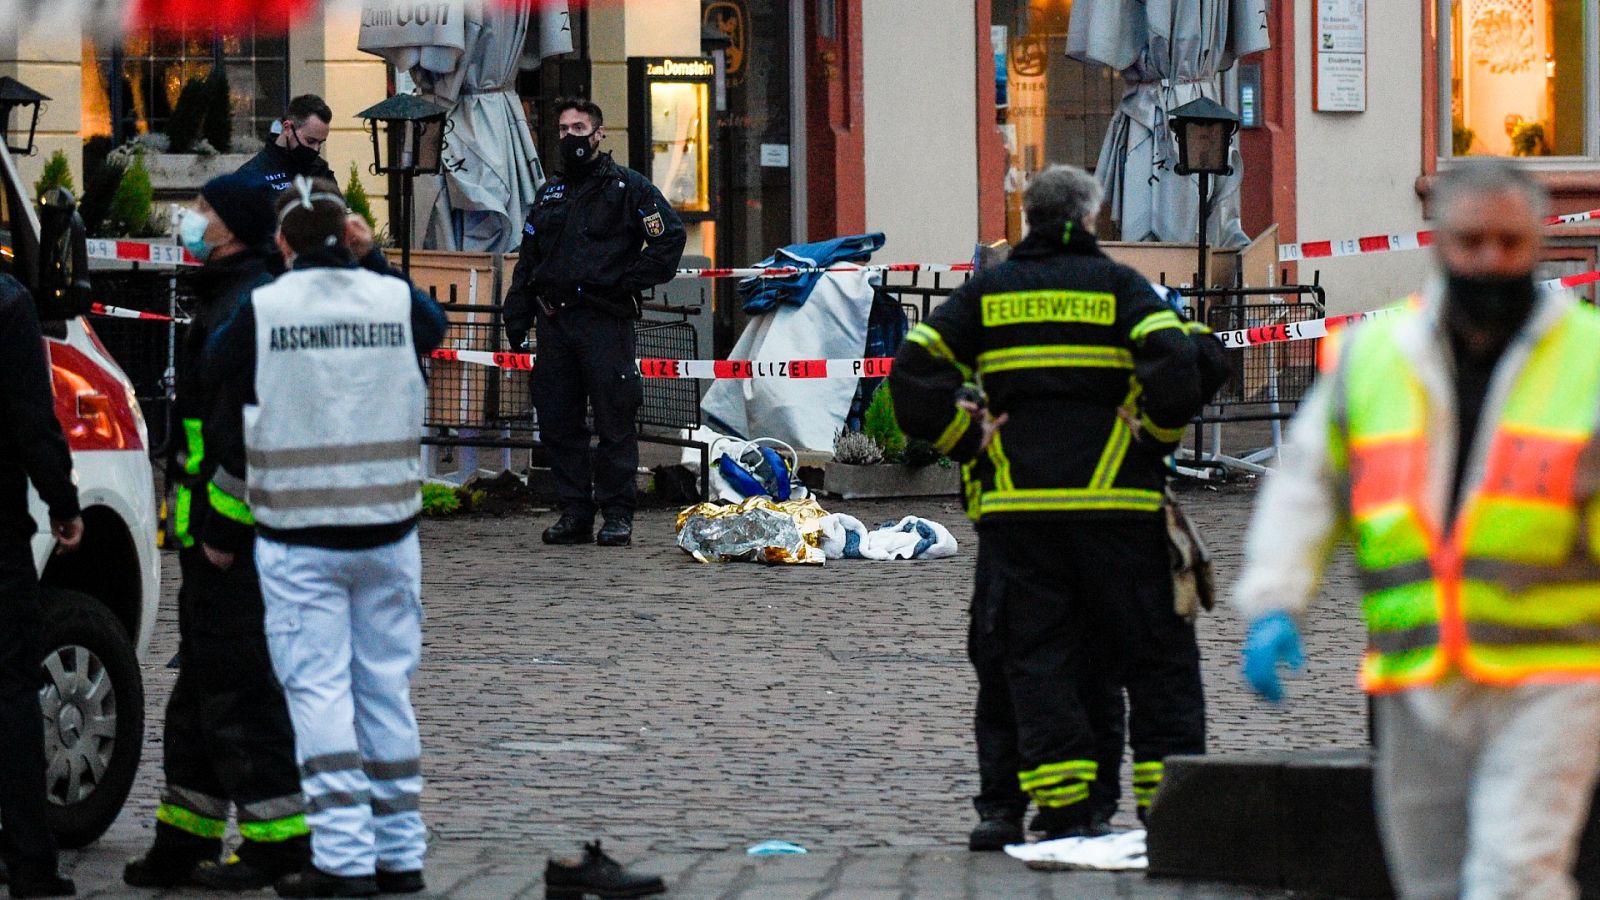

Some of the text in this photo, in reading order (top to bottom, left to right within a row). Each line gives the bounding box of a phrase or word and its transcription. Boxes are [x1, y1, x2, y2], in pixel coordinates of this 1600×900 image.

[646, 59, 714, 76] Zum Domstein
[986, 297, 1110, 320] FEUERWEHR
[270, 322, 406, 351] ABSCHNITTSLEITER
[1221, 324, 1302, 346] POLIZEI
[732, 361, 808, 377] POLIZEI
